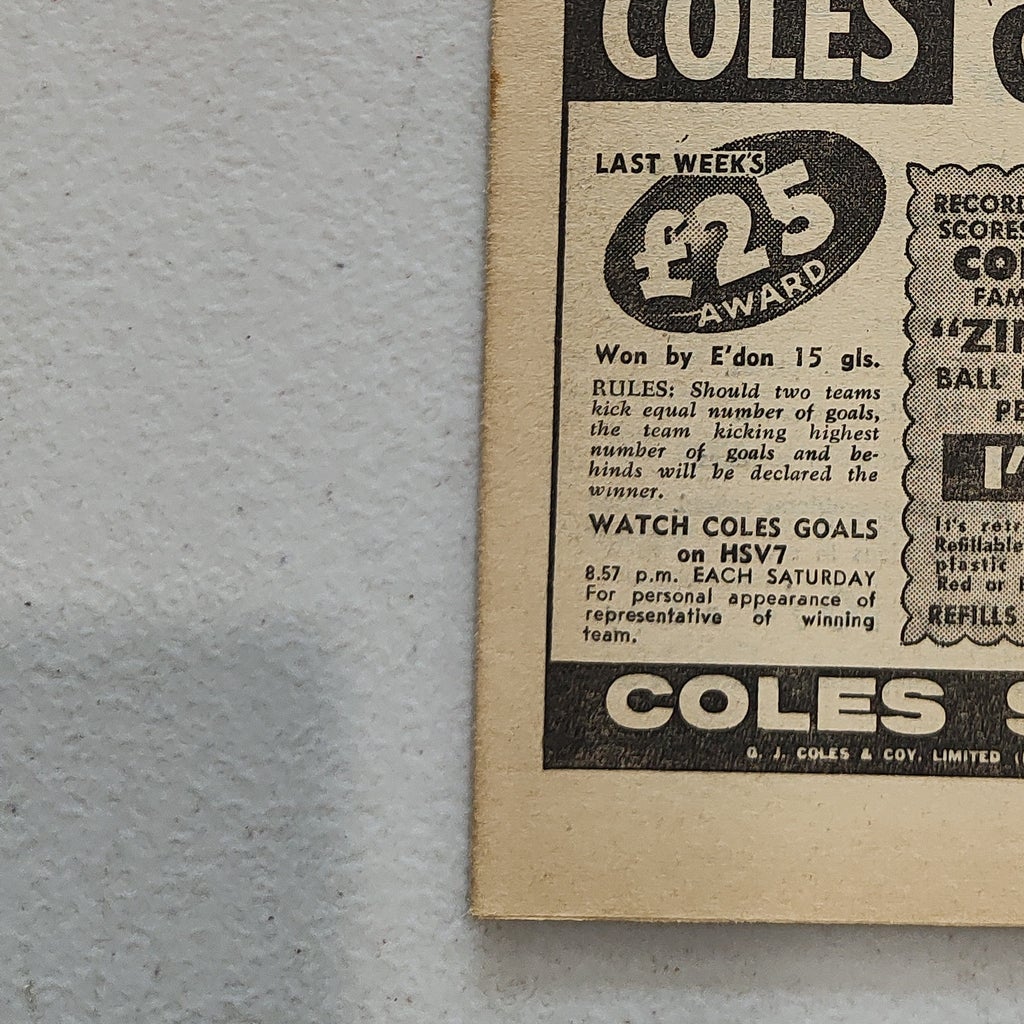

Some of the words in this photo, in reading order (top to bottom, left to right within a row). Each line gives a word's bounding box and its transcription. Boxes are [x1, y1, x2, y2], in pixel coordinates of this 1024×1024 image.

[596, 153, 660, 174] LAST
[674, 149, 767, 177] WEEK'S
[632, 159, 836, 299] £25
[698, 259, 827, 327] AWARD
[596, 344, 646, 364] Won
[667, 345, 692, 369] by
[711, 345, 773, 366] E'don
[796, 347, 822, 367] 15
[842, 348, 879, 371] gls.
[593, 379, 674, 397] RULES:
[691, 381, 759, 398] Should
[776, 386, 810, 399] two
[826, 387, 880, 400] teams
[936, 368, 1003, 390] BALL
[592, 400, 630, 416] kick
[643, 402, 696, 420] equal
[709, 403, 783, 419] number
[795, 404, 814, 421] of
[825, 404, 879, 423] goals,
[591, 420, 620, 436] the
[644, 424, 690, 438] team
[714, 422, 786, 443] kicking
[810, 424, 879, 443] highest
[591, 441, 666, 458] number
[686, 443, 705, 461] of
[726, 444, 774, 463] goals
[794, 445, 830, 461] and
[851, 445, 878, 461] be-
[589, 460, 641, 478] hinds
[658, 462, 696, 479] will
[712, 463, 734, 480] be
[751, 464, 831, 481] declared
[849, 465, 877, 482] the
[589, 486, 663, 499] winner.
[589, 514, 688, 535] WATCH
[703, 516, 780, 537] COLES
[794, 518, 877, 539] GOALS
[678, 549, 704, 562] on
[721, 543, 786, 564] HSV7
[936, 556, 1007, 574] plastic
[585, 565, 620, 581] 8.57
[636, 571, 677, 584] p.m.
[694, 567, 752, 584] EACH
[767, 569, 875, 588] SATURDAY
[937, 575, 971, 591] Red
[985, 579, 1005, 591] or
[586, 585, 615, 601] For
[632, 588, 712, 606] personal
[729, 594, 840, 609] appearance
[857, 591, 875, 607] of
[586, 608, 721, 625] representative
[753, 609, 771, 625] of
[802, 611, 874, 631] winning
[928, 604, 1017, 626] REFILLS
[583, 626, 636, 643] team.
[605, 673, 946, 738] COLES
[773, 746, 786, 759] J.
[796, 746, 850, 760] COLES
[860, 748, 872, 760] &
[883, 748, 922, 762] COY.
[932, 749, 1001, 763] LIMITED
